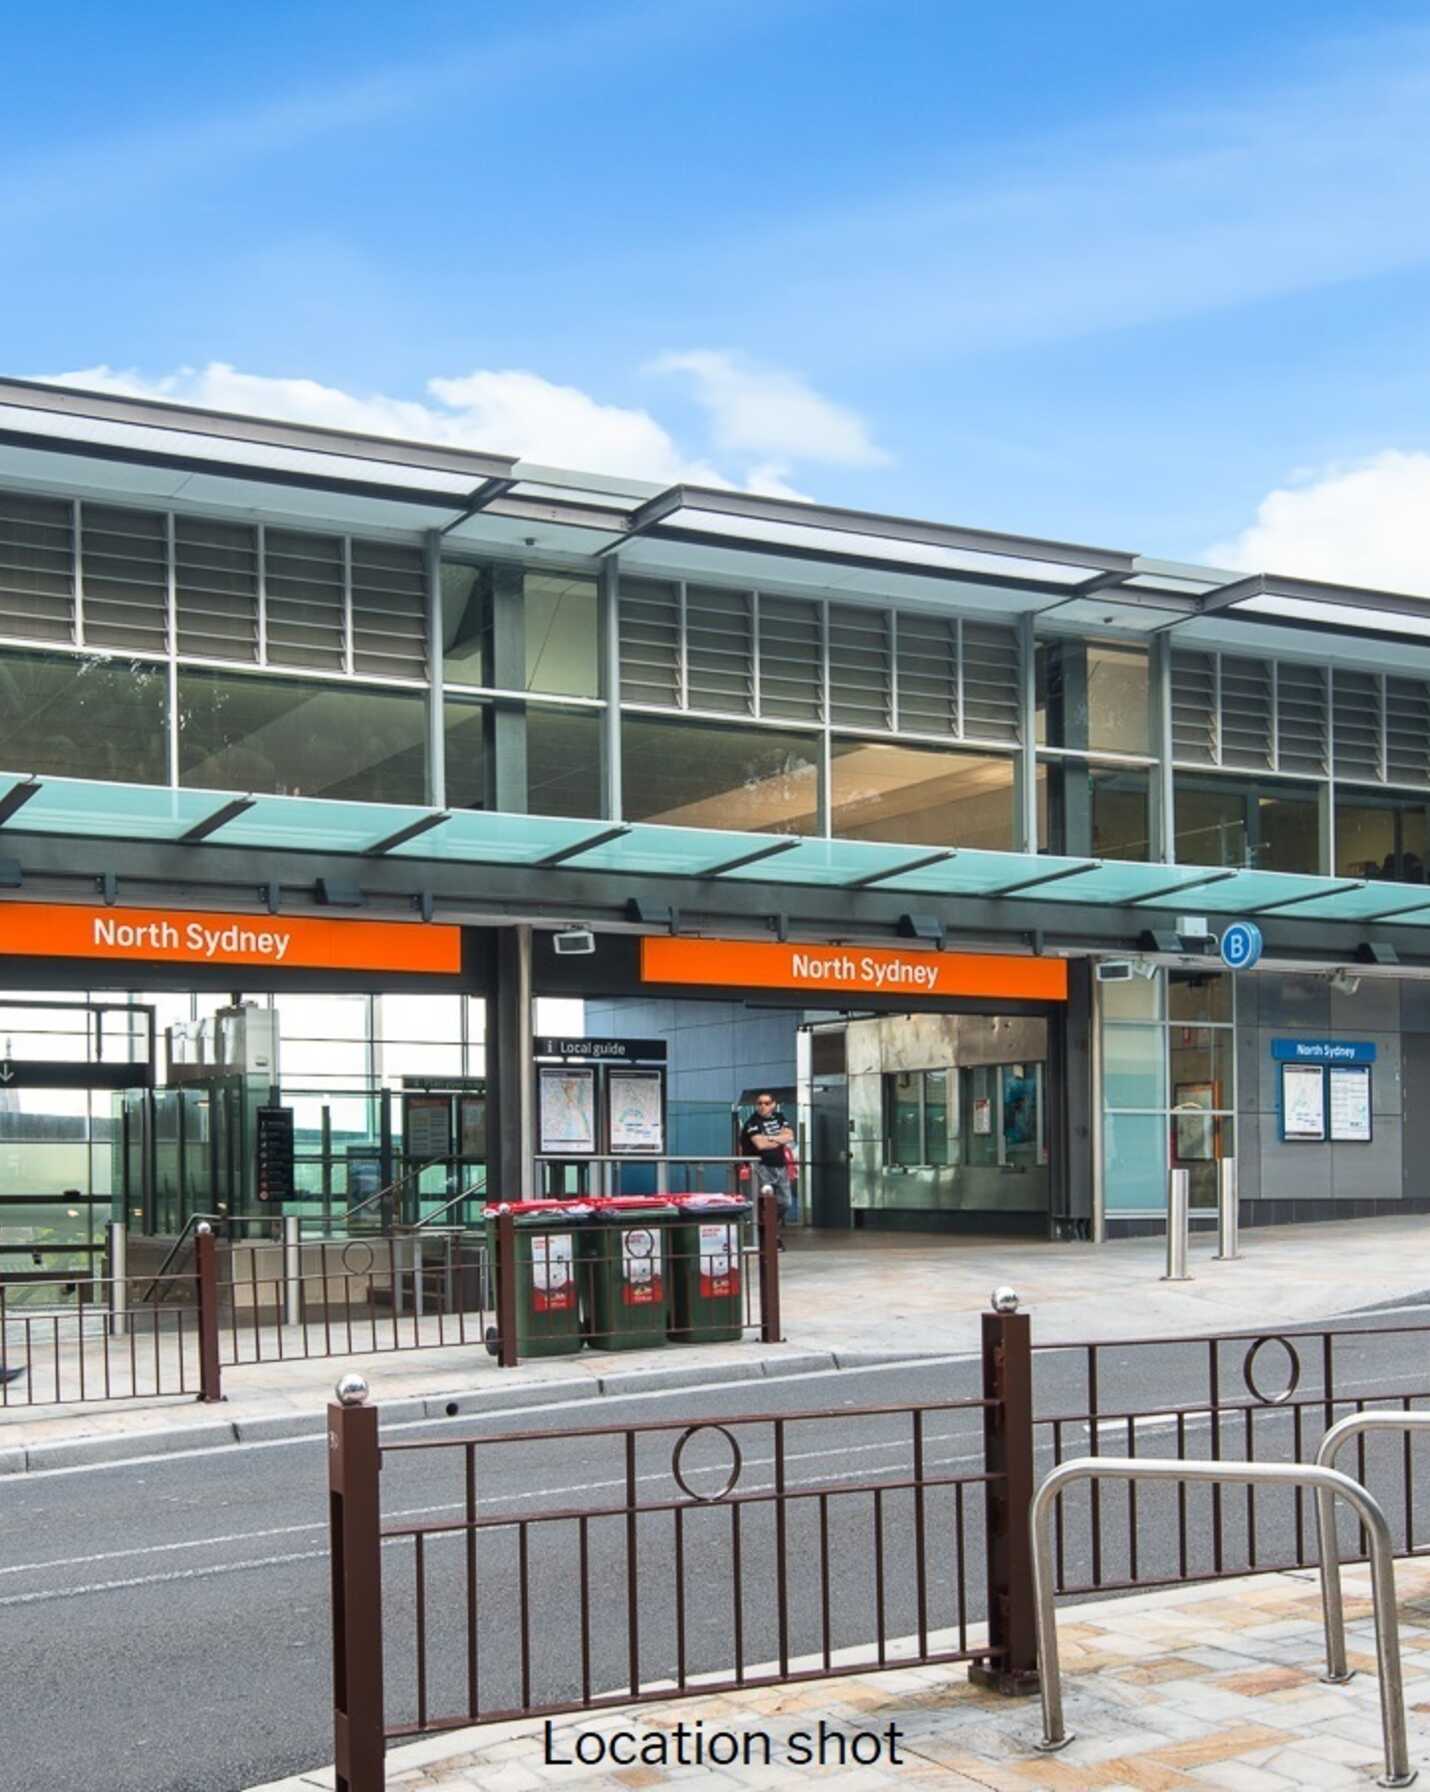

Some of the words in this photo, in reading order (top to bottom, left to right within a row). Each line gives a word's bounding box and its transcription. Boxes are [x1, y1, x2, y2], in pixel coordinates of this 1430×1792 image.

[93, 919, 179, 949] North
[186, 923, 291, 959] Sydney
[1230, 934, 1245, 959] B
[792, 954, 855, 981] North
[861, 957, 939, 989] Sydney
[560, 1041, 592, 1055] Local
[593, 1042, 625, 1056] guide
[1296, 1044, 1323, 1056] North
[1324, 1044, 1356, 1059] Sydney
